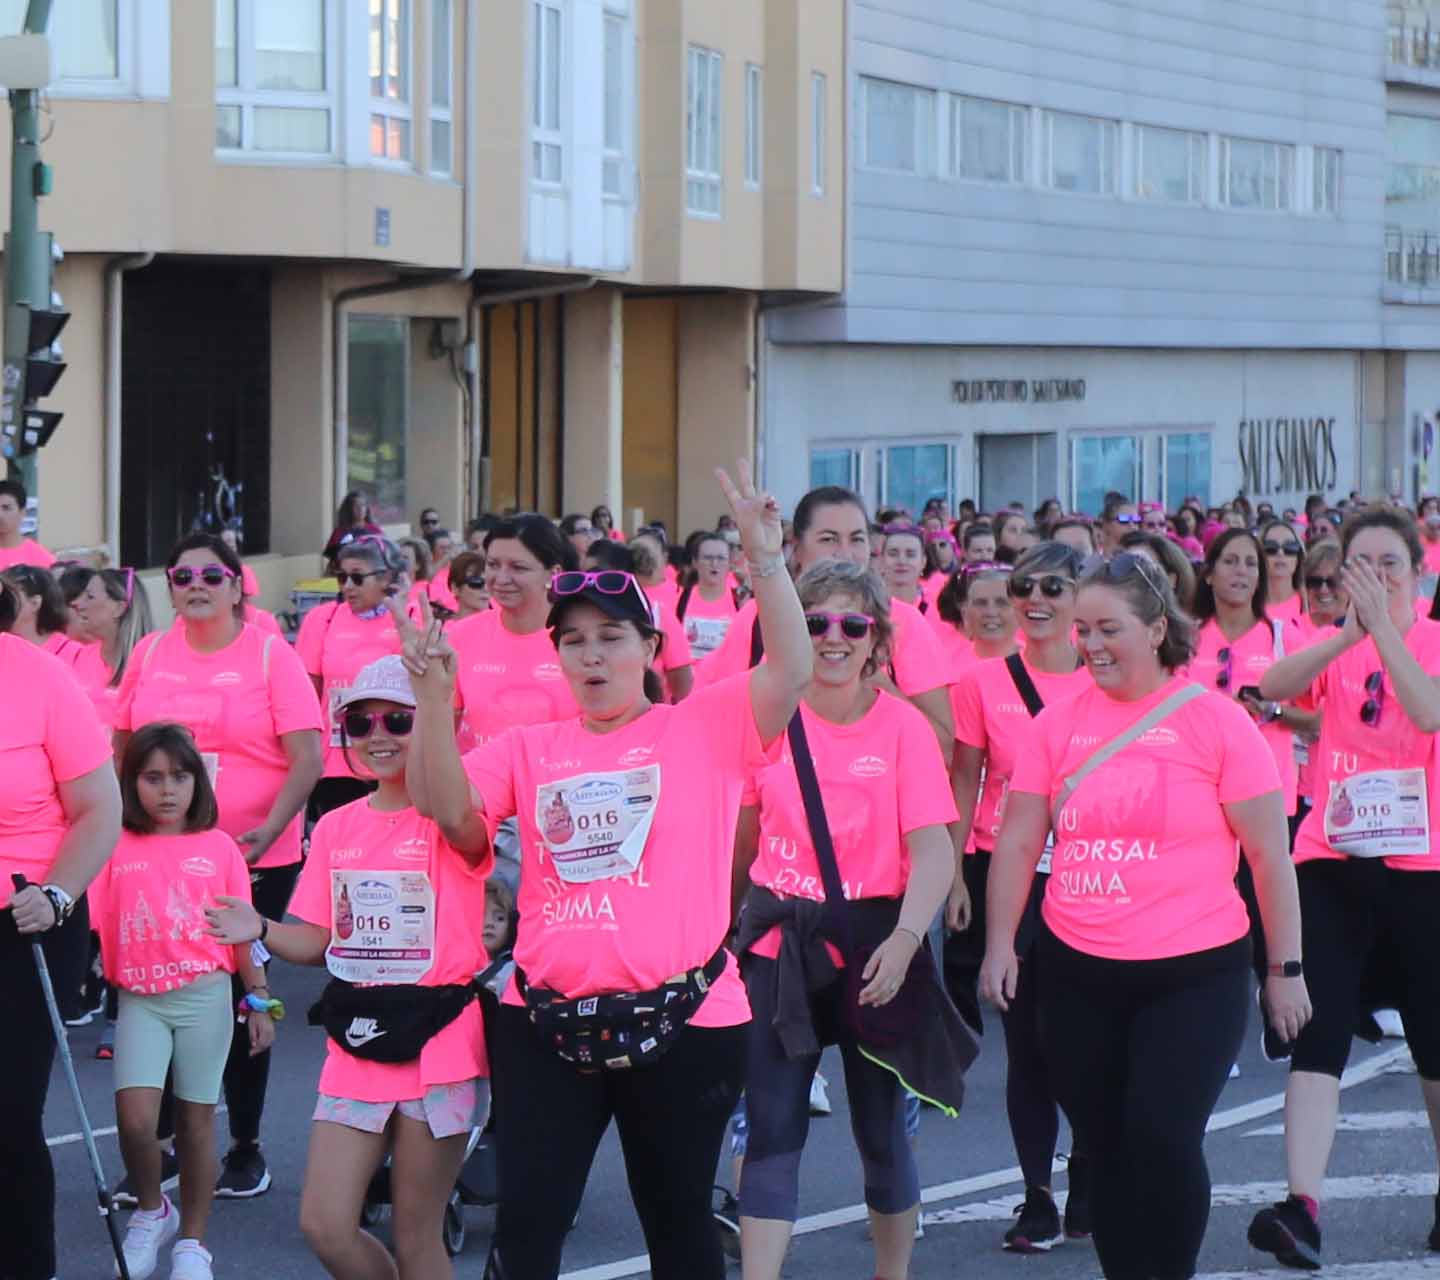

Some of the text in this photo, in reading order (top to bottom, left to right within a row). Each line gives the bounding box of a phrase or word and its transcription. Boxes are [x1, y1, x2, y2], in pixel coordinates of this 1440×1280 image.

[1238, 417, 1337, 495] SALESIANOS
[1332, 752, 1358, 773] TU
[577, 810, 618, 831] 016
[1357, 805, 1391, 818] 016
[587, 831, 614, 845] 5540
[768, 836, 797, 861] TU
[1060, 871, 1127, 896] SUMA
[543, 893, 615, 926] SUMA
[356, 915, 391, 932] 016
[361, 935, 383, 946] 5541
[124, 967, 146, 982] TU
[348, 1016, 377, 1036] NIKE
